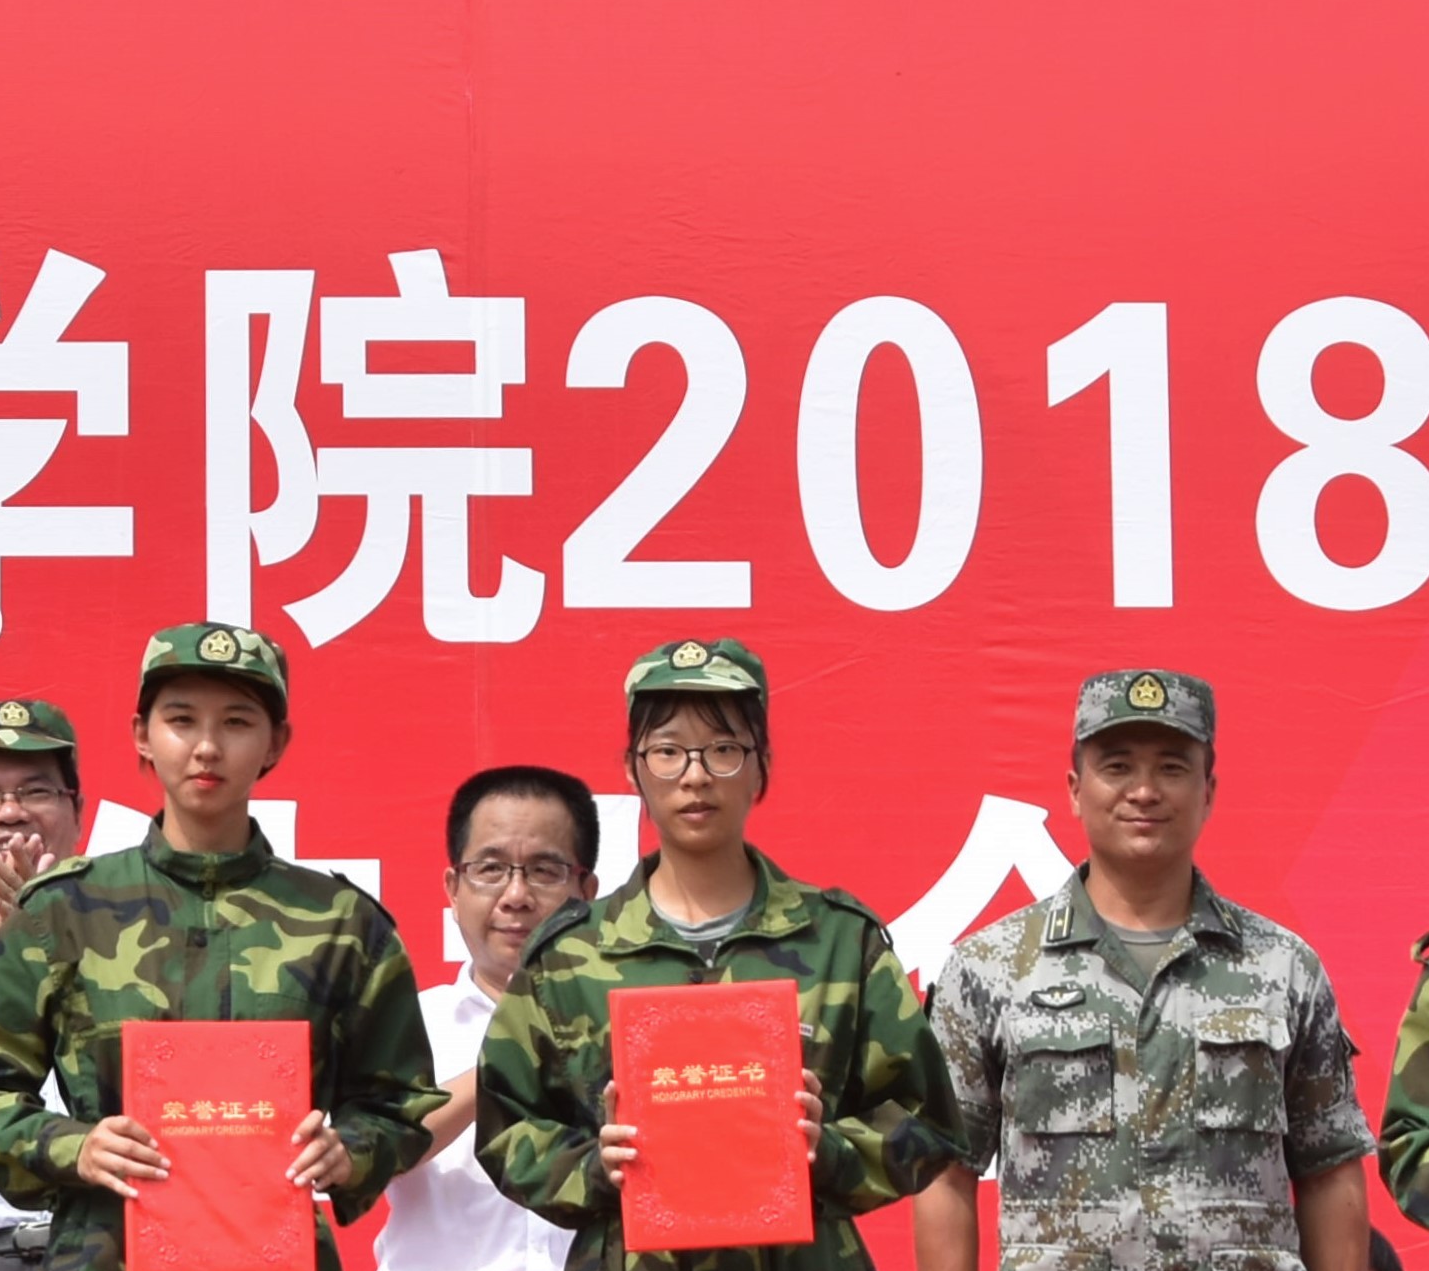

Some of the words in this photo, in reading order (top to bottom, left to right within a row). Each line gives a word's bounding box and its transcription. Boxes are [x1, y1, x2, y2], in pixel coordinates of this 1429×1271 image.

[651, 1062, 766, 1086] 荣誉证书
[651, 1090, 705, 1103] HONORARY
[707, 1087, 767, 1099] CREDENTIAL
[160, 1100, 275, 1120] 荣誉证书
